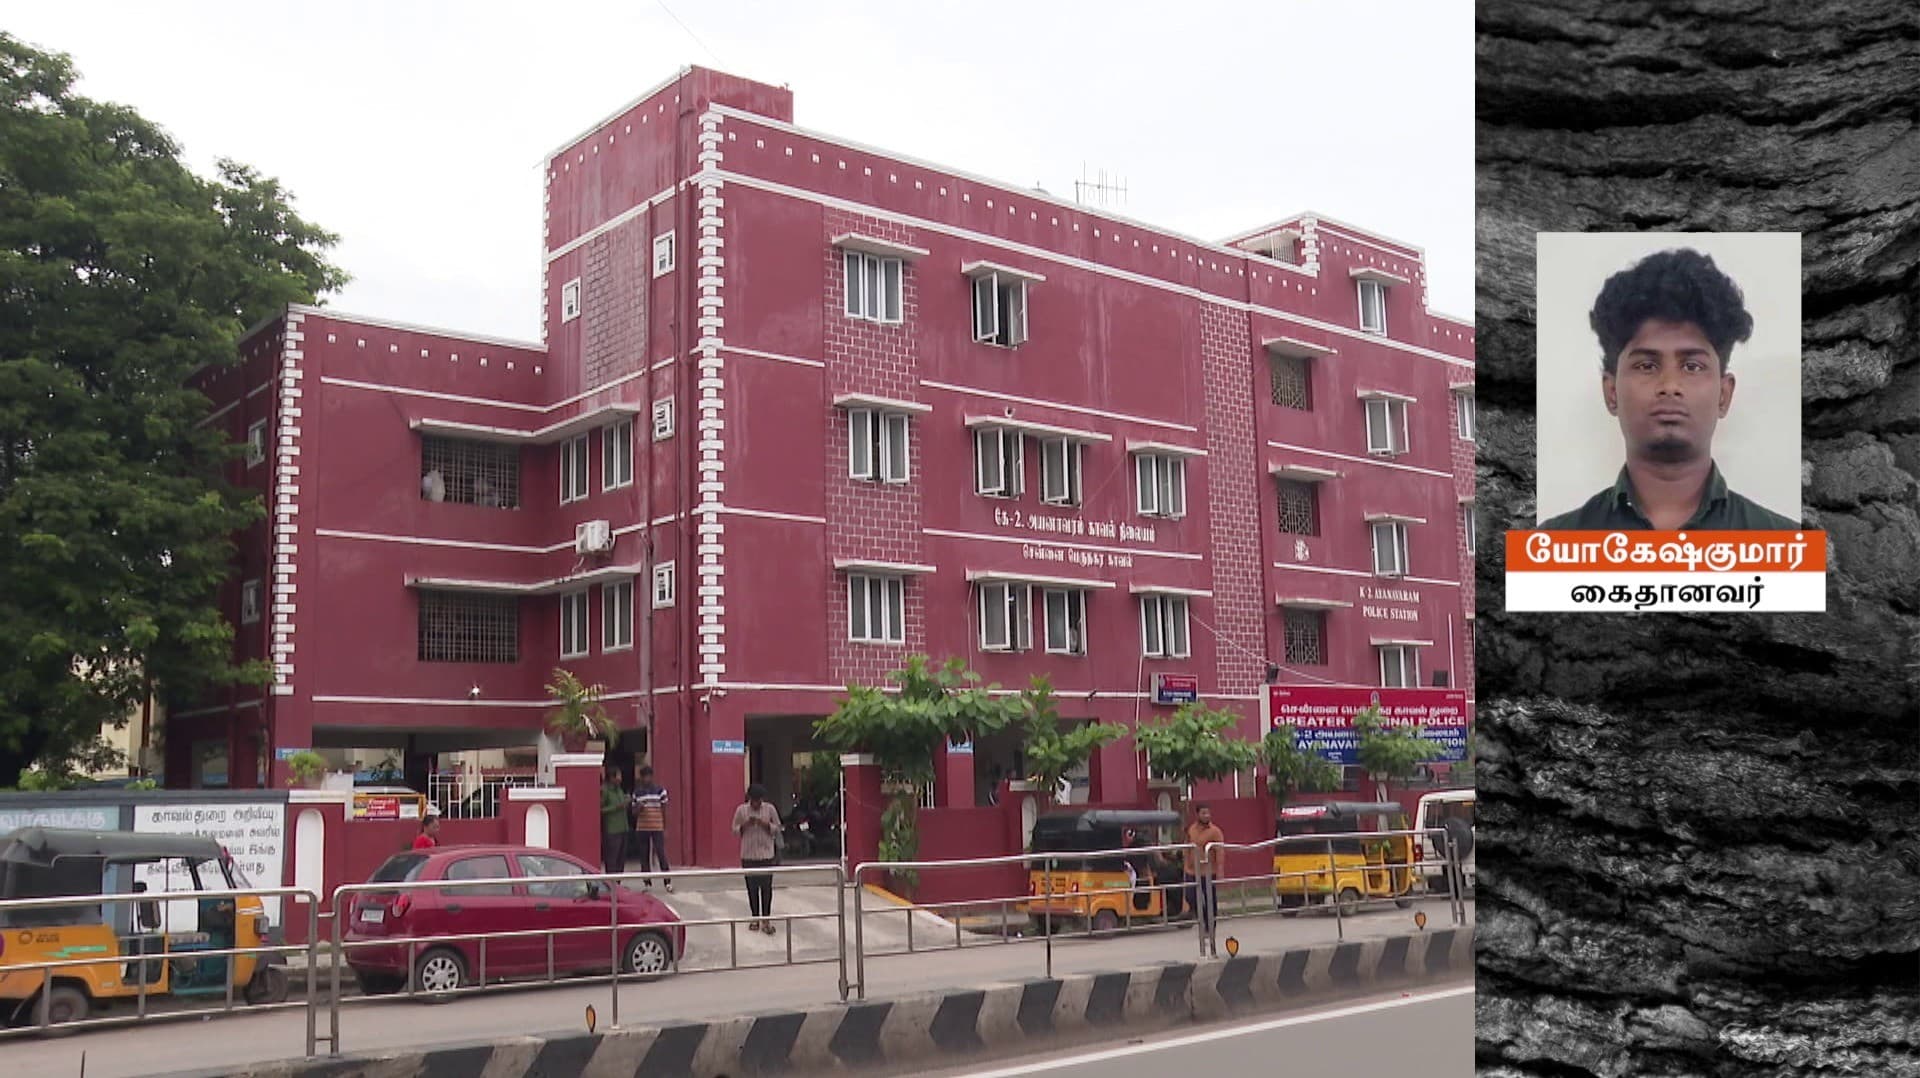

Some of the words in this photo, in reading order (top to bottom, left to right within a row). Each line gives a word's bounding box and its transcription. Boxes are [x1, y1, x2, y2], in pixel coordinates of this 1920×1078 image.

[1362, 605, 1389, 619] POLICE
[1390, 608, 1419, 622] STATION
[1273, 716, 1347, 727] GREATER
[1418, 716, 1465, 726] POLICE
